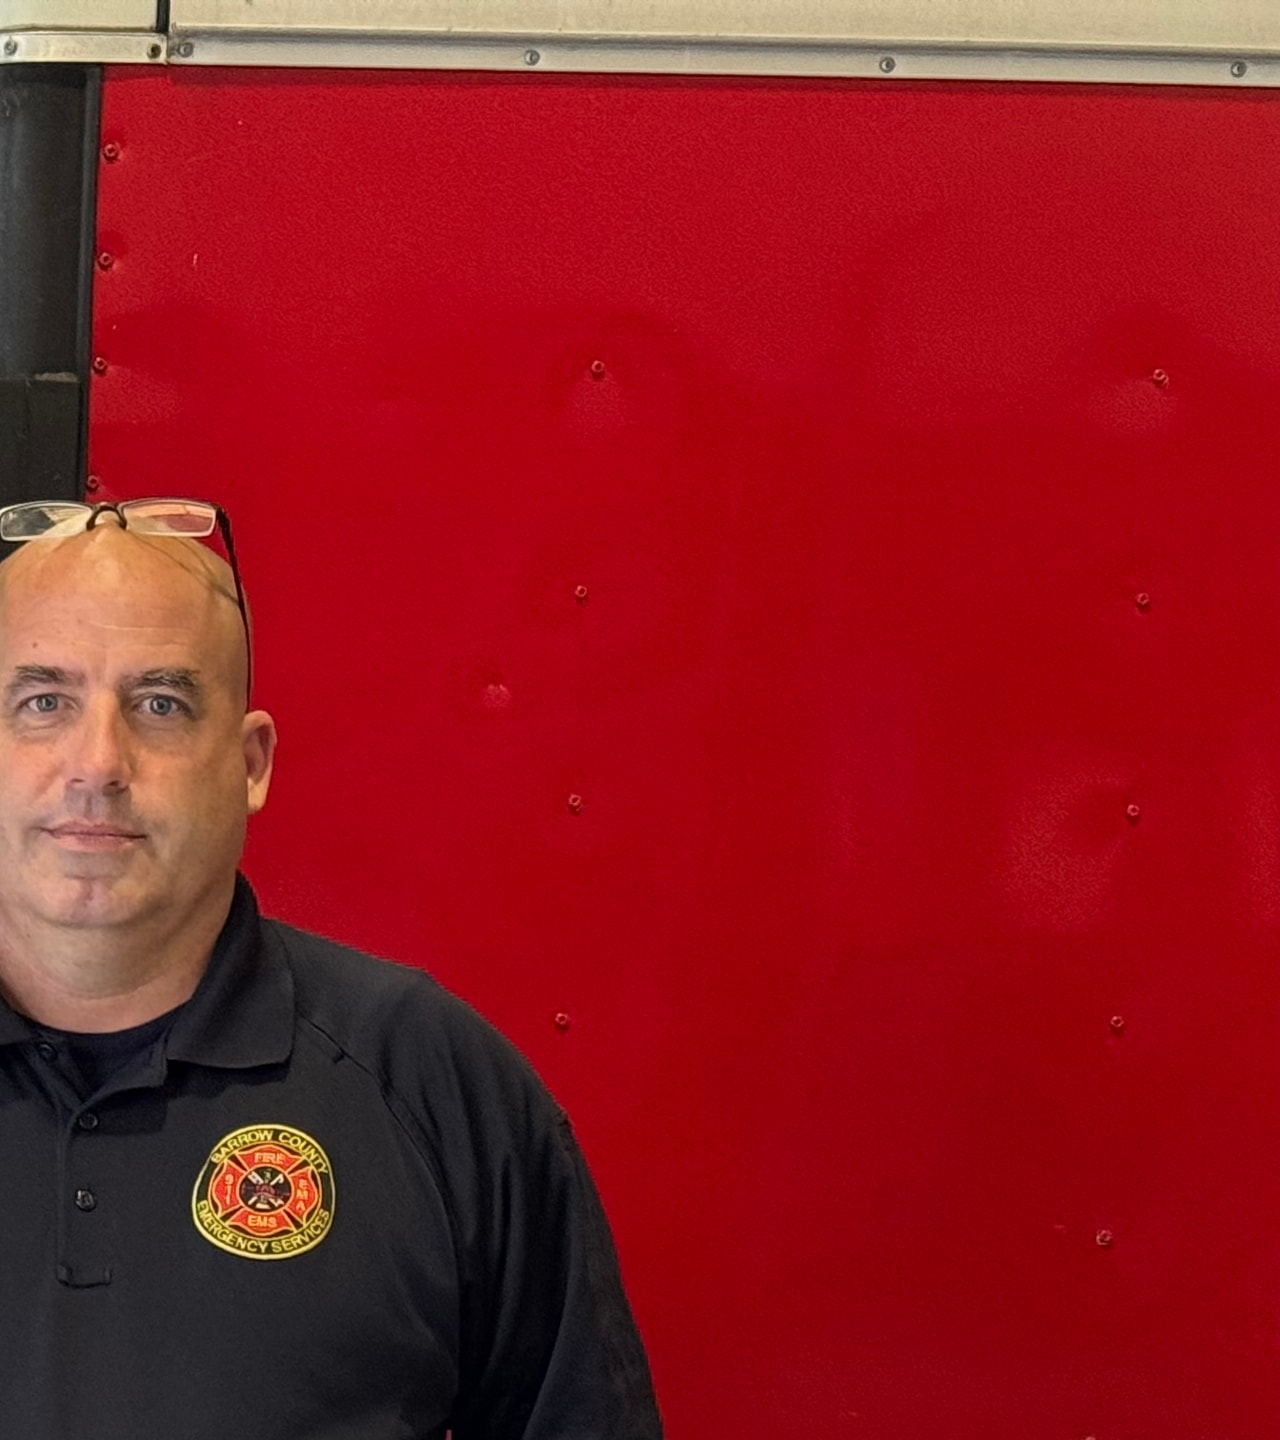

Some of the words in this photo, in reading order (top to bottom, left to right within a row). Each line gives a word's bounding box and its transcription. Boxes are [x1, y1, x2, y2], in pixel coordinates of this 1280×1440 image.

[211, 1130, 274, 1164] BARROW
[278, 1132, 329, 1174] COUNTY
[253, 1152, 286, 1164] FIRE
[197, 1200, 268, 1254] EMERGENCY
[271, 1208, 330, 1254] SERVICES
[247, 1215, 278, 1228] EMS
